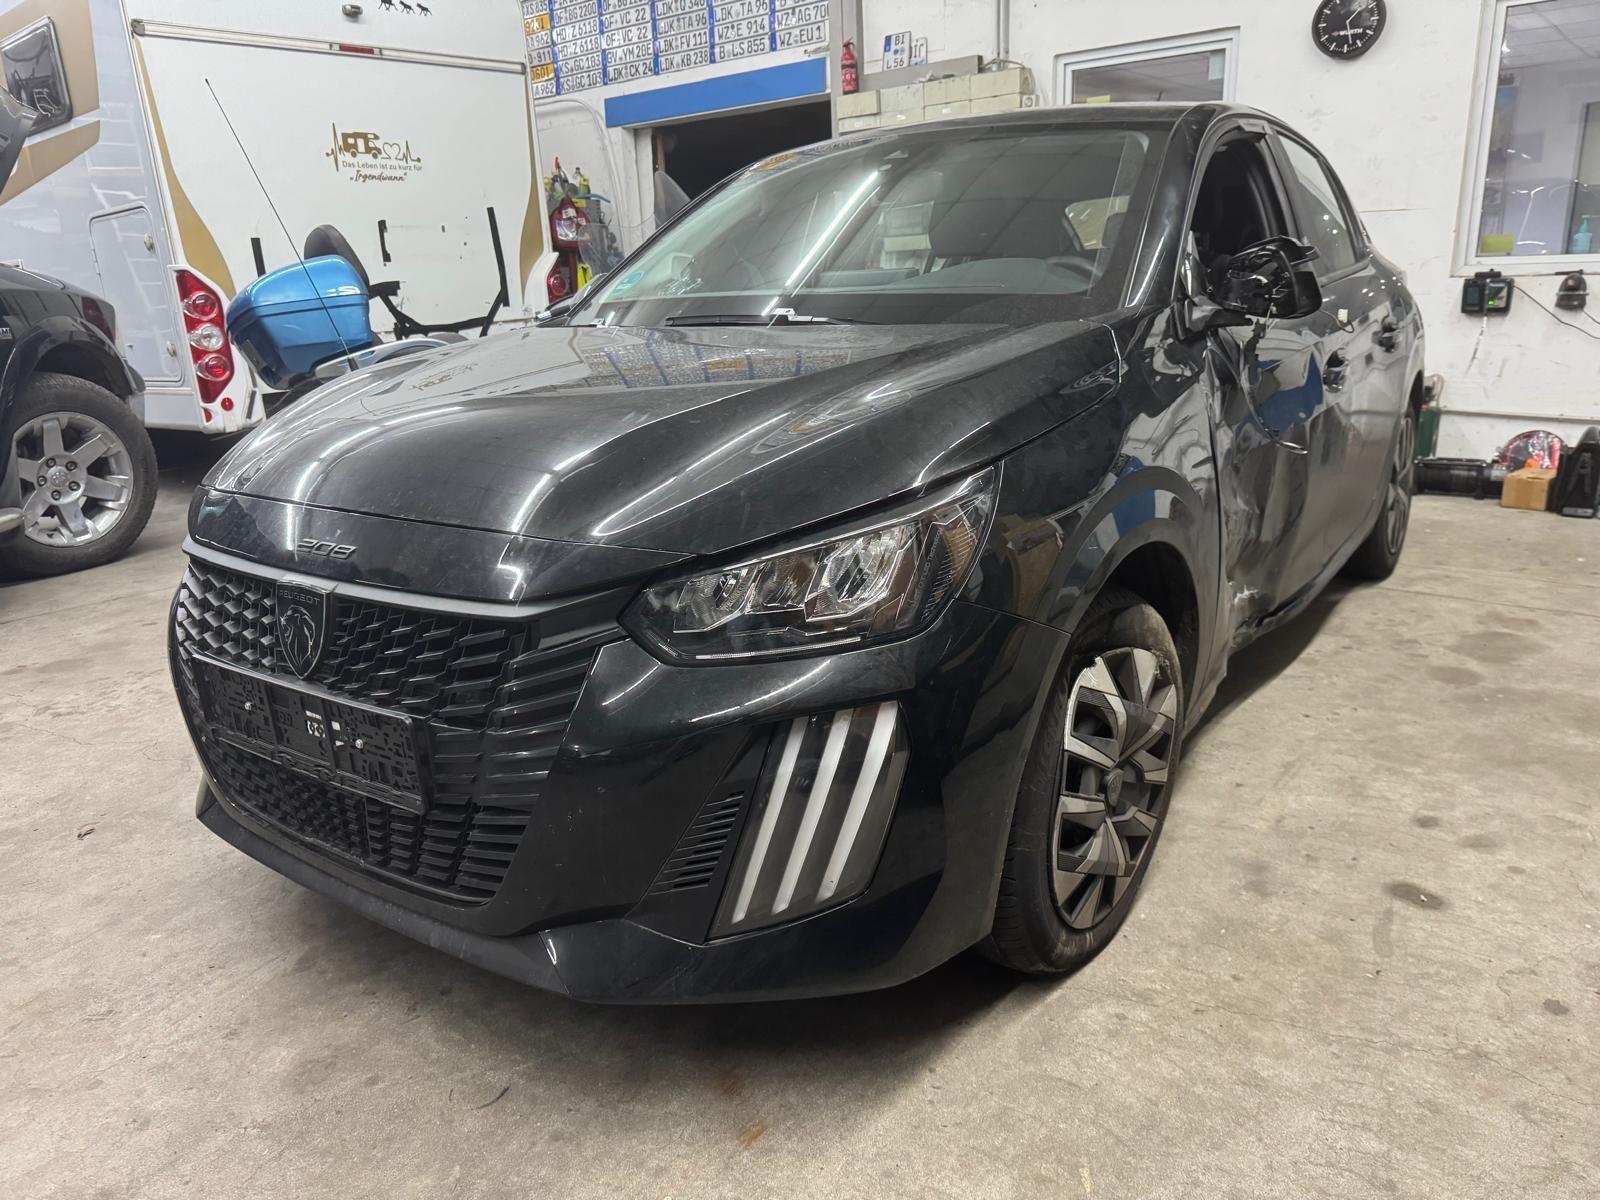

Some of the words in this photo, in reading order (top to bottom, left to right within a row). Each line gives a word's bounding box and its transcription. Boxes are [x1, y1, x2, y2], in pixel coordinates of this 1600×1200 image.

[604, 14, 614, 30] OF
[620, 11, 631, 25] VC
[635, 7, 646, 22] 22
[656, 1, 673, 17] LDK
[715, 5, 733, 22] LDK
[740, 2, 753, 17] TA
[797, 7, 811, 24] AG
[571, 24, 577, 38] Z
[578, 20, 597, 36] 6118
[681, 16, 693, 31] TA
[695, 12, 707, 27] 96
[718, 26, 730, 41] WZ
[737, 23, 743, 37] E
[746, 18, 766, 35] 914
[573, 42, 579, 55] Z
[580, 37, 599, 53] 6118
[606, 33, 616, 47] OF
[621, 29, 633, 43] VC
[637, 26, 648, 40] 22
[680, 34, 691, 50] FV
[693, 31, 708, 47] 111
[779, 32, 793, 48] WZ
[799, 27, 813, 43] EU
[815, 25, 822, 40] 1
[719, 46, 726, 60] B
[746, 37, 766, 54] 855
[586, 54, 601, 69] 103
[660, 56, 675, 72] LDK
[681, 53, 692, 69] KB
[693, 50, 709, 65] 238
[893, 56, 905, 68] 56
[587, 71, 602, 88] 103
[608, 64, 624, 82] LDK
[629, 63, 641, 77] CK
[357, 161, 378, 169] Leben
[380, 162, 388, 170] ist
[399, 163, 412, 171] kurz
[297, 538, 356, 560] 208
[280, 590, 320, 605] PEUGEOT
